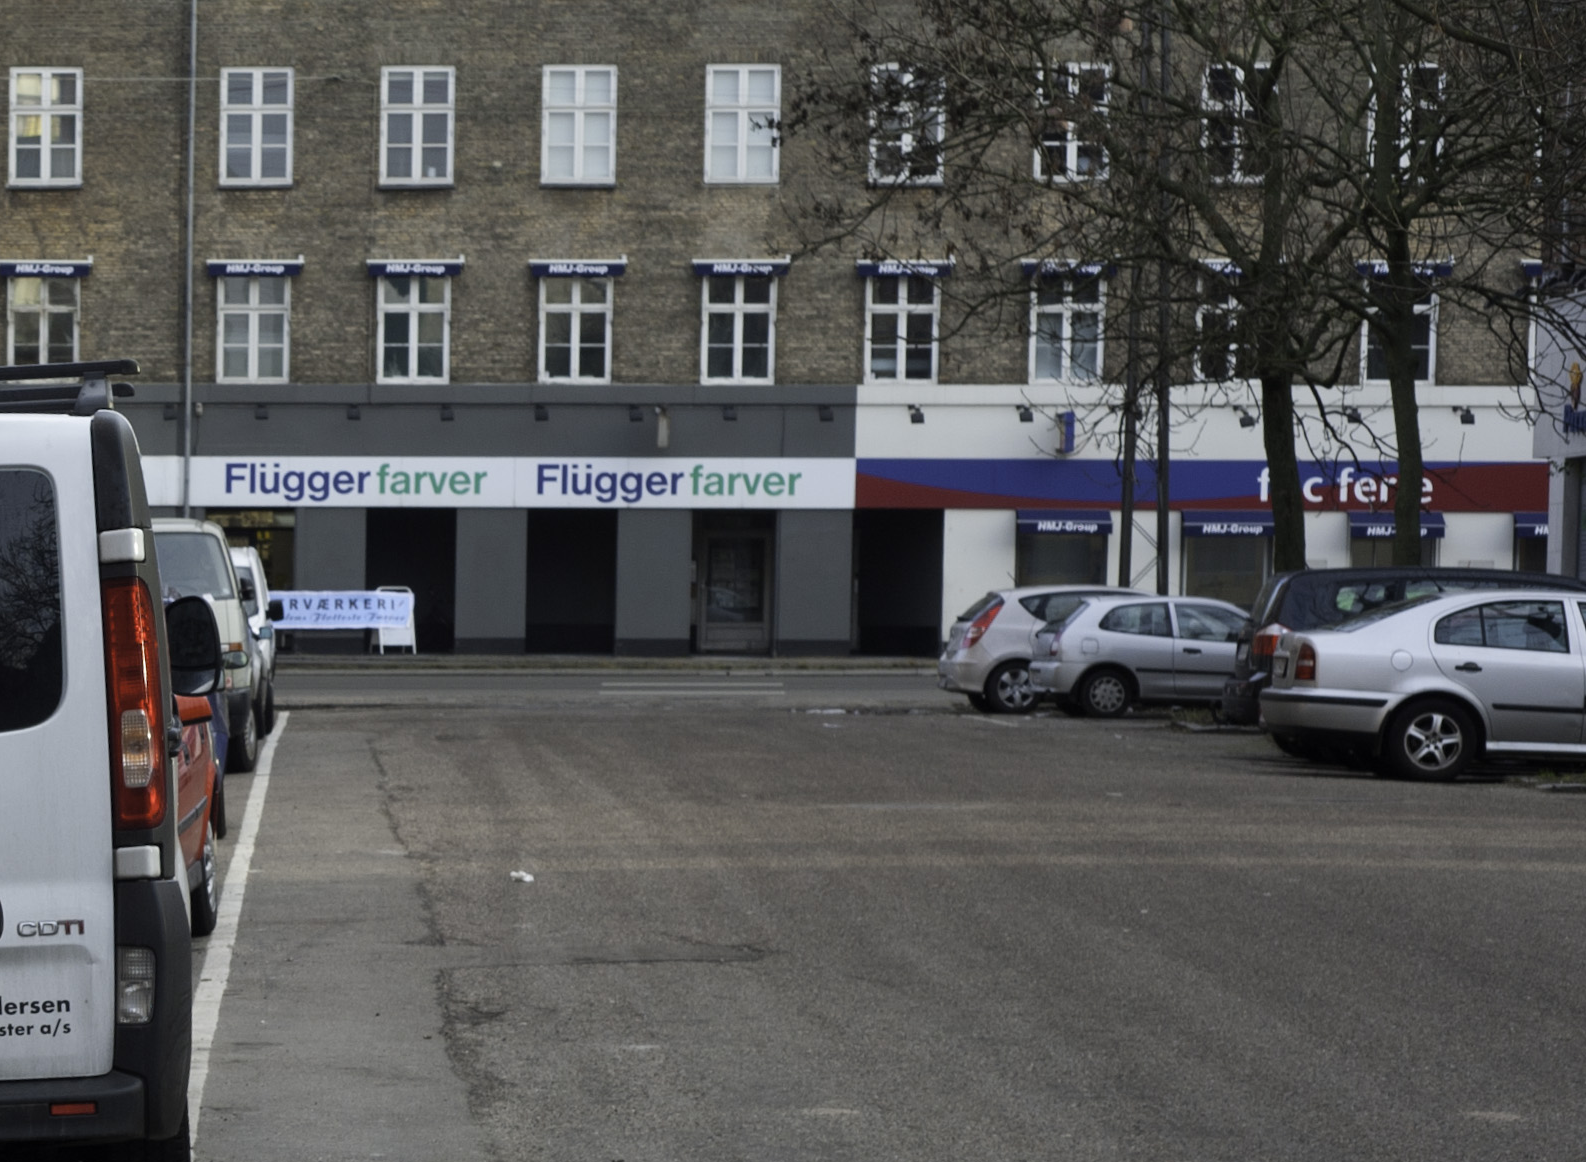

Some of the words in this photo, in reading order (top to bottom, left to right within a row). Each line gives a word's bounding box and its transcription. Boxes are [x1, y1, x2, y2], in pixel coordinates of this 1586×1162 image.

[15, 264, 75, 276] HMJ-Group
[226, 263, 285, 275] HMJ-Group
[386, 263, 446, 275] HMJ-Group
[549, 263, 609, 275] HMJ-Group
[225, 463, 371, 501] Flügger
[376, 463, 488, 495] farver
[537, 464, 684, 503] Flügger
[689, 464, 802, 496] farver
[1257, 467, 1324, 503] fc
[1336, 467, 1434, 503] fere
[1037, 521, 1098, 533] HMJ-Group
[1202, 523, 1264, 535] HMJ-Group
[16, 919, 85, 937] CDTI
[40, 1018, 72, 1038] a/s
